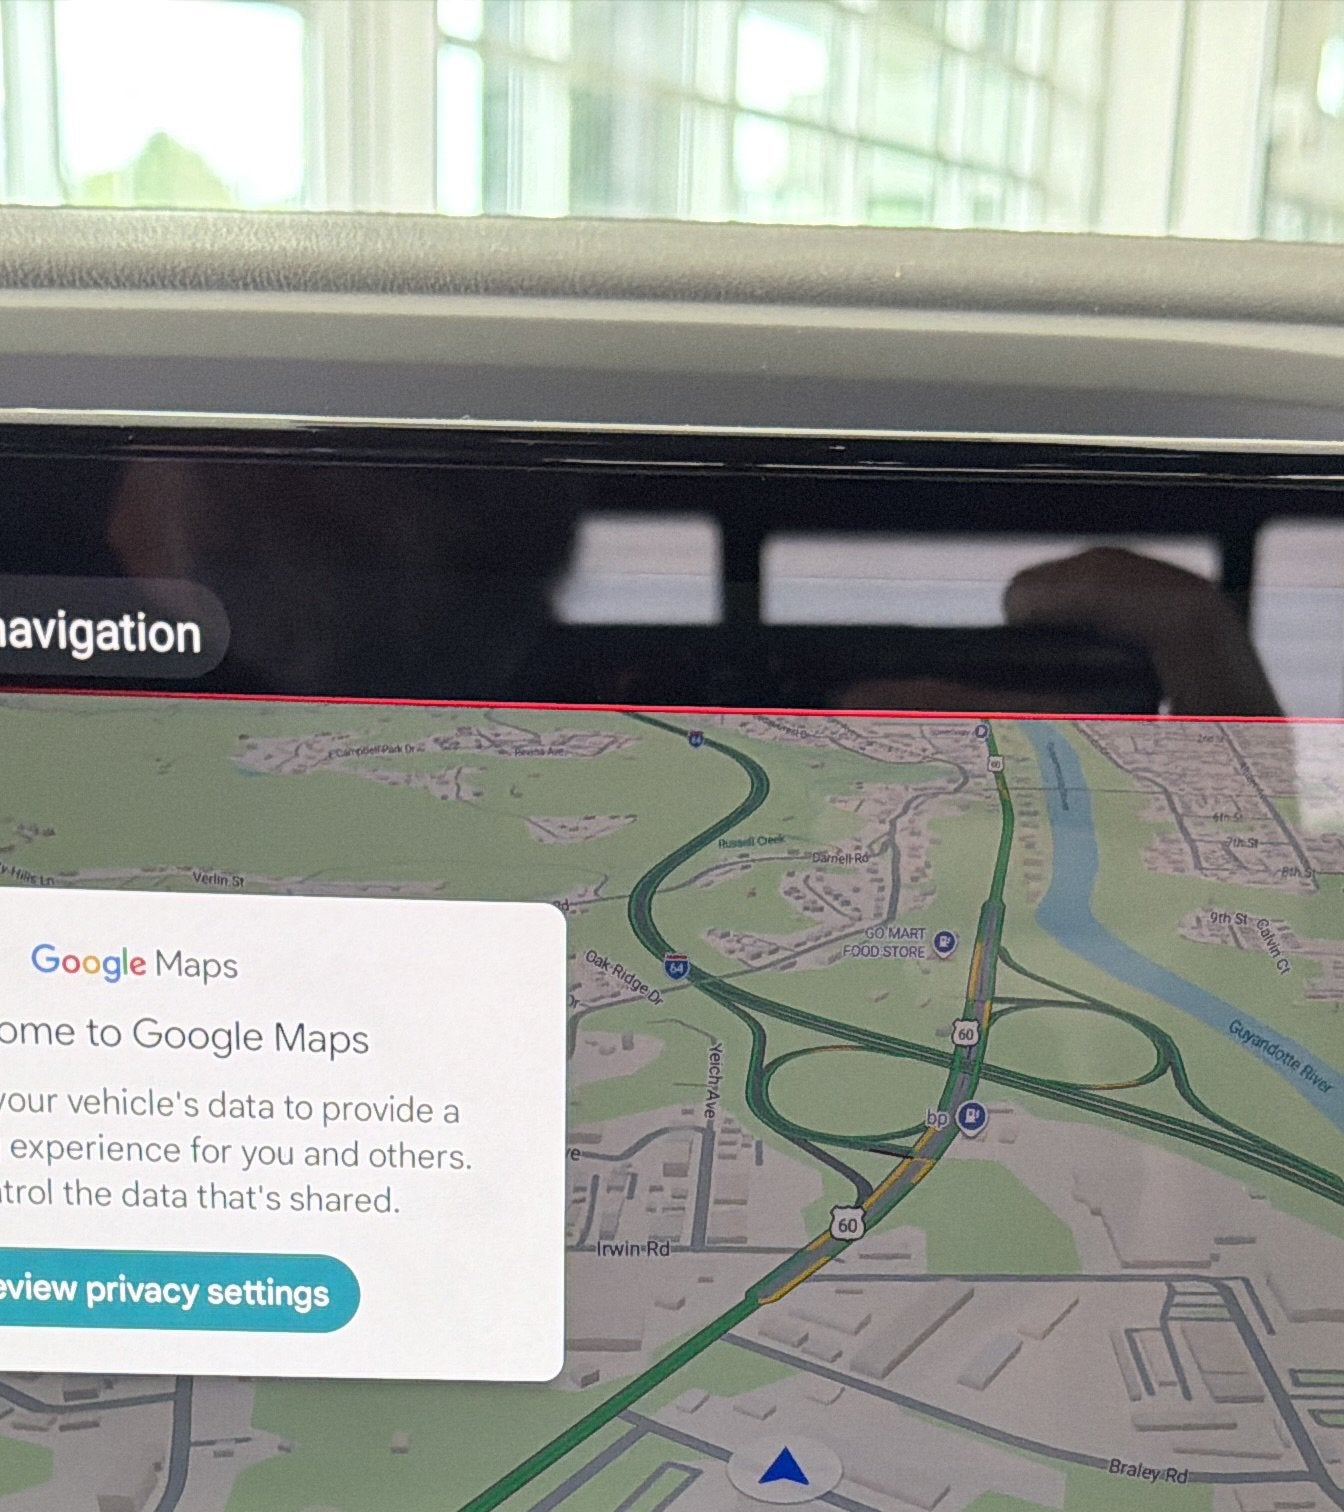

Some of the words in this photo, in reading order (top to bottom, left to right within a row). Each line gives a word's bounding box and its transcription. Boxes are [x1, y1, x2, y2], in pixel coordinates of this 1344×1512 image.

[1226, 837, 1243, 848] 7th
[1247, 838, 1259, 849] St
[812, 852, 851, 865] Darnell
[852, 852, 870, 864] Rd
[10, 865, 38, 885] Hills
[39, 875, 56, 887] Ln
[191, 869, 227, 887] Verlin
[229, 875, 246, 888] St
[1280, 866, 1300, 877] 8th
[1209, 911, 1232, 924] 9th
[1235, 912, 1249, 925] St
[864, 927, 885, 941] GO
[887, 927, 927, 941] MART
[842, 944, 880, 958] FOOD
[881, 945, 927, 959] STORE
[1256, 918, 1282, 961] Calvin
[1275, 957, 1292, 976] Ct
[31, 943, 147, 984] Google
[155, 949, 239, 985] Maps
[668, 961, 685, 975] 64
[584, 949, 610, 972] Oak
[611, 963, 650, 997] Ridge
[647, 988, 664, 1005] Dr
[86, 1018, 122, 1047] to
[133, 1017, 263, 1059] Google
[274, 1021, 370, 1061] Maps
[958, 1028, 974, 1042] 60
[708, 1041, 725, 1088] Yeich
[1228, 1019, 1302, 1072] Guyandotte
[1299, 1063, 1335, 1094] River
[67, 1086, 200, 1118] vehicle's
[208, 1090, 274, 1119] data
[283, 1095, 314, 1121] to
[322, 1094, 434, 1128] provide
[442, 1103, 460, 1124] a
[704, 1089, 721, 1119] Ave
[926, 1108, 949, 1127] bp
[10, 1132, 181, 1167] experience
[190, 1135, 232, 1164] for
[241, 1144, 295, 1172] you
[304, 1140, 360, 1168] and
[368, 1141, 472, 1170] others.
[63, 1178, 113, 1207] the
[121, 1180, 188, 1209] data
[197, 1182, 281, 1211] that's
[289, 1184, 401, 1214] shared.
[837, 1217, 859, 1235] 60
[596, 1240, 641, 1258] Irwin
[646, 1240, 671, 1258] Rd
[85, 1273, 200, 1311] privacy
[207, 1277, 331, 1314] settings
[1107, 1457, 1161, 1484] Braley
[1164, 1468, 1189, 1485] Rd
